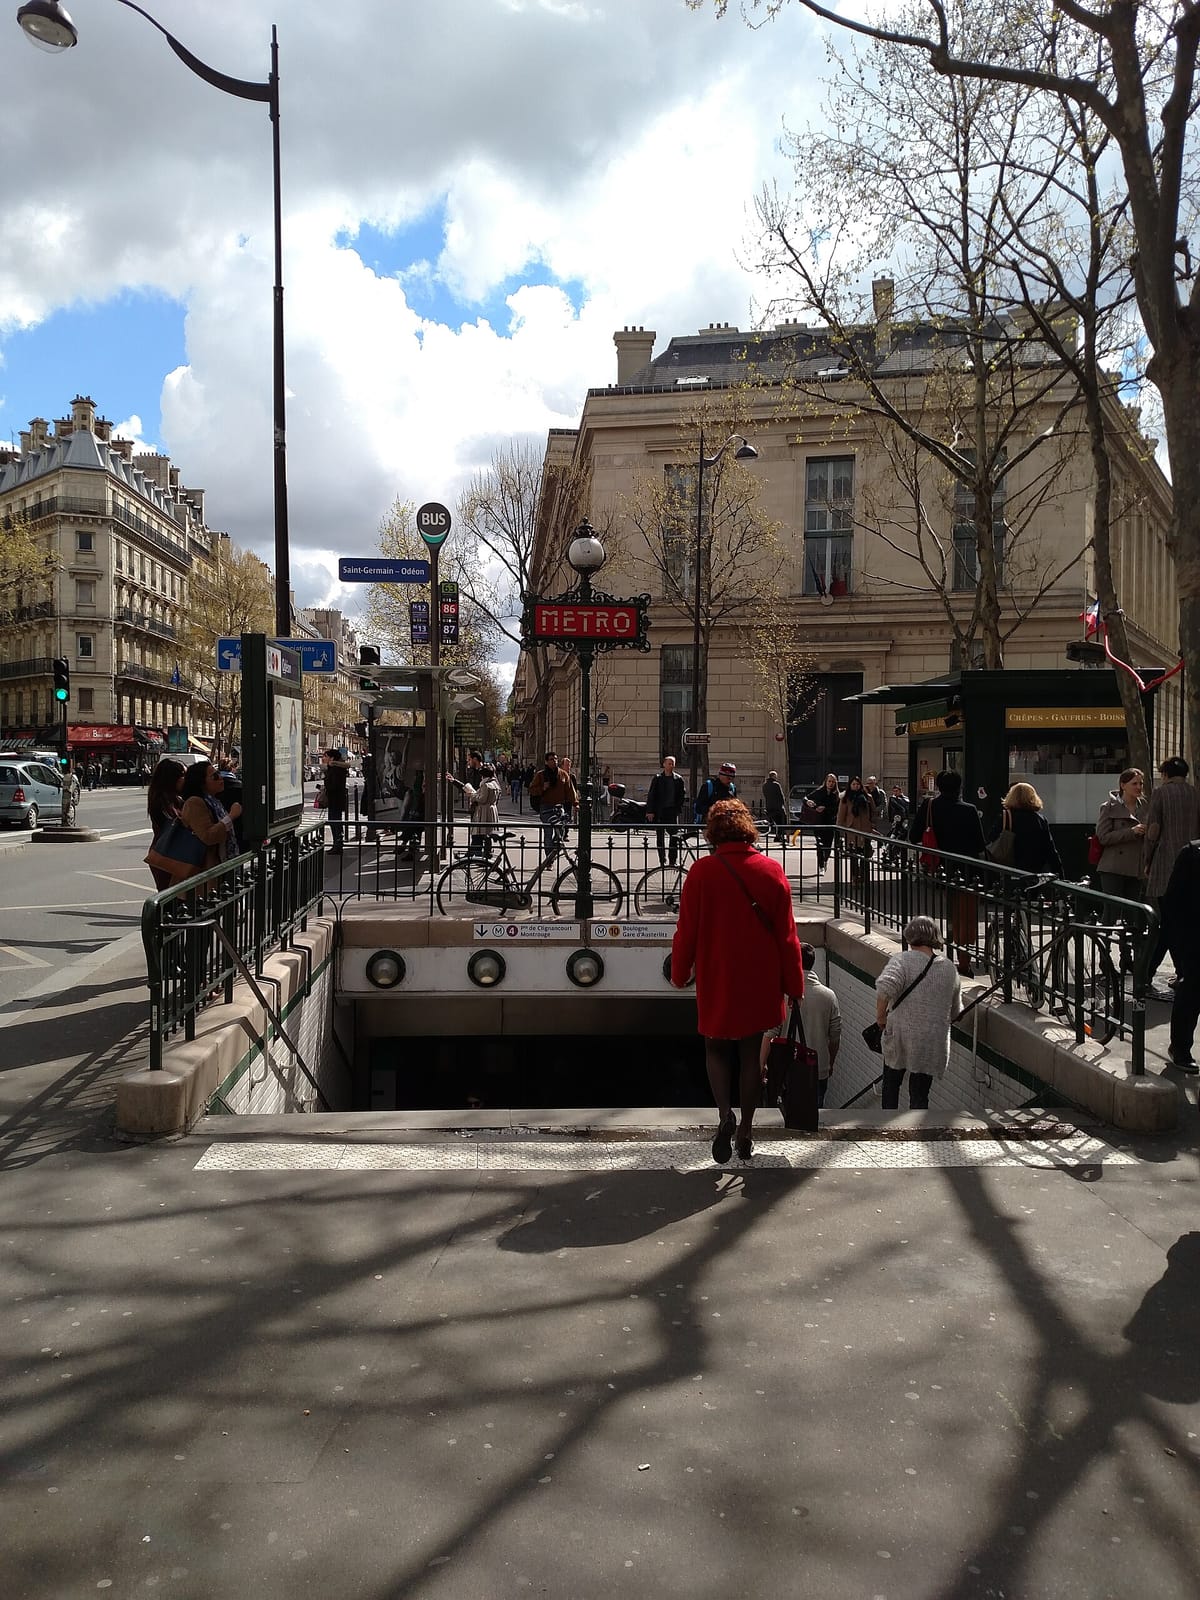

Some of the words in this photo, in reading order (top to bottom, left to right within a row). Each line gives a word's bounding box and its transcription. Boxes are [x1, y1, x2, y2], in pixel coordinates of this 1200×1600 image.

[421, 512, 446, 526] BUS
[342, 565, 394, 575] Saint-Germain
[401, 566, 425, 576] Odéon
[443, 583, 455, 592] 63
[443, 604, 456, 614] 86
[541, 609, 631, 634] METRO
[443, 625, 456, 634] 87
[1051, 712, 1092, 721] GAUFRES
[1099, 712, 1126, 721] BOISS
[622, 925, 648, 933] Boulogne
